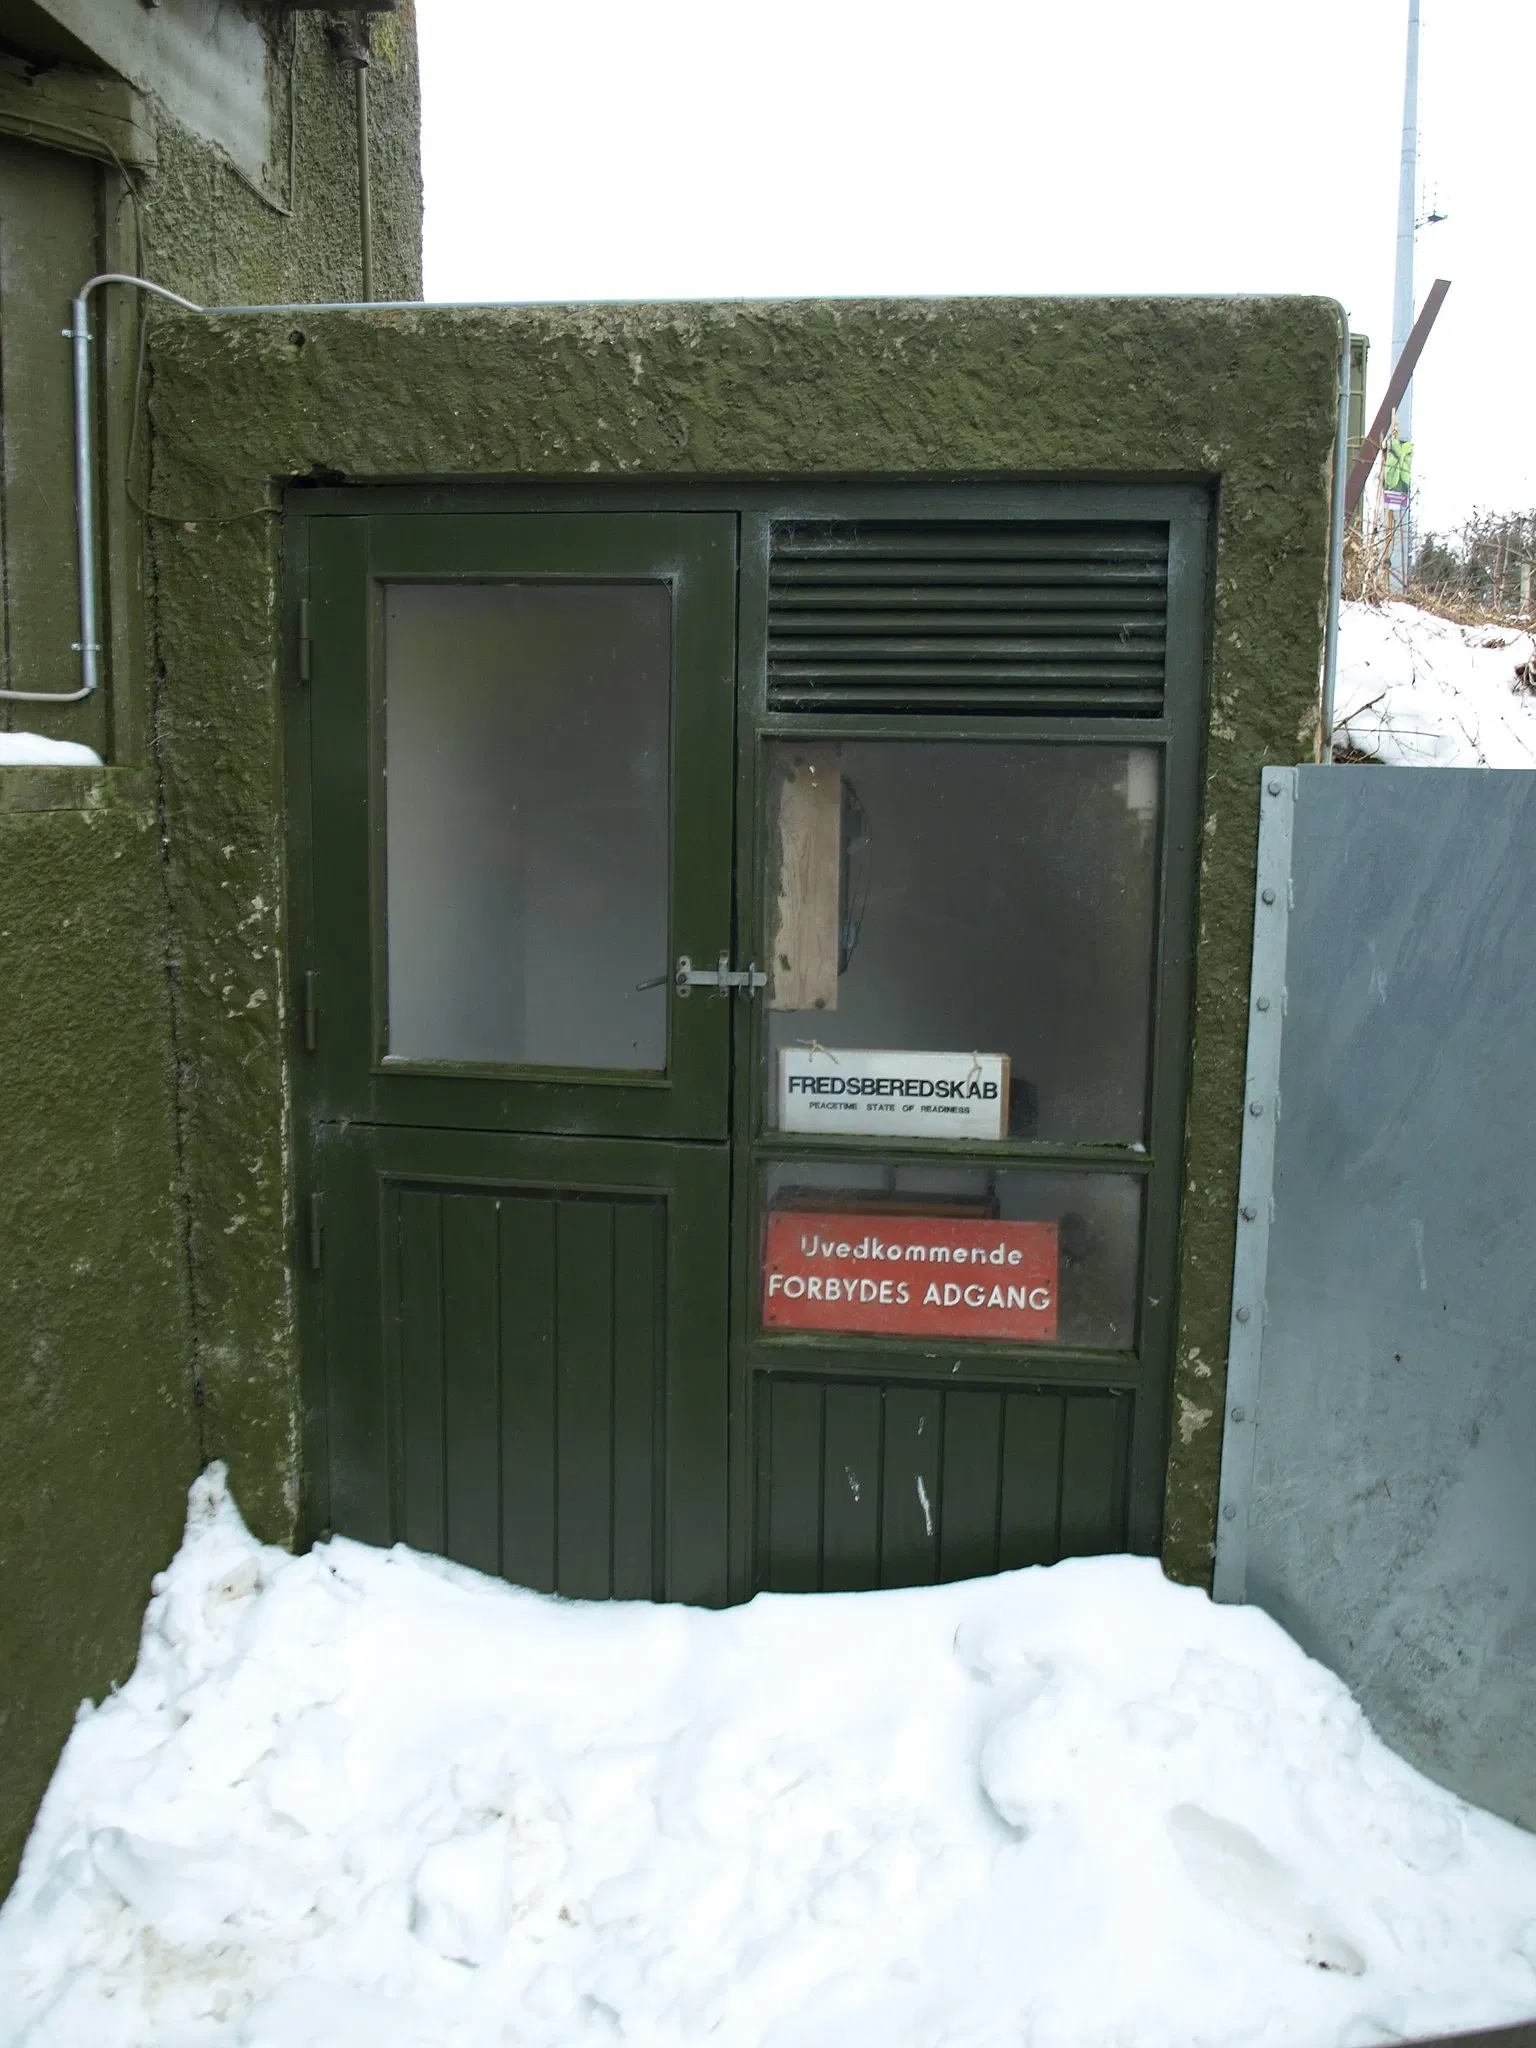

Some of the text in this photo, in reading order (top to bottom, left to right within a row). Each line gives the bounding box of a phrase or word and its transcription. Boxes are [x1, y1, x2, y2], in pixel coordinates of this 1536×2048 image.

[788, 1075, 998, 1100] FREDSBEREDSKAB
[809, 1101, 970, 1115] PEACETIME STATE OF READINESS
[801, 1235, 1023, 1266] Uvedkommende
[767, 1273, 1051, 1311] FORBYDES ADGANG
